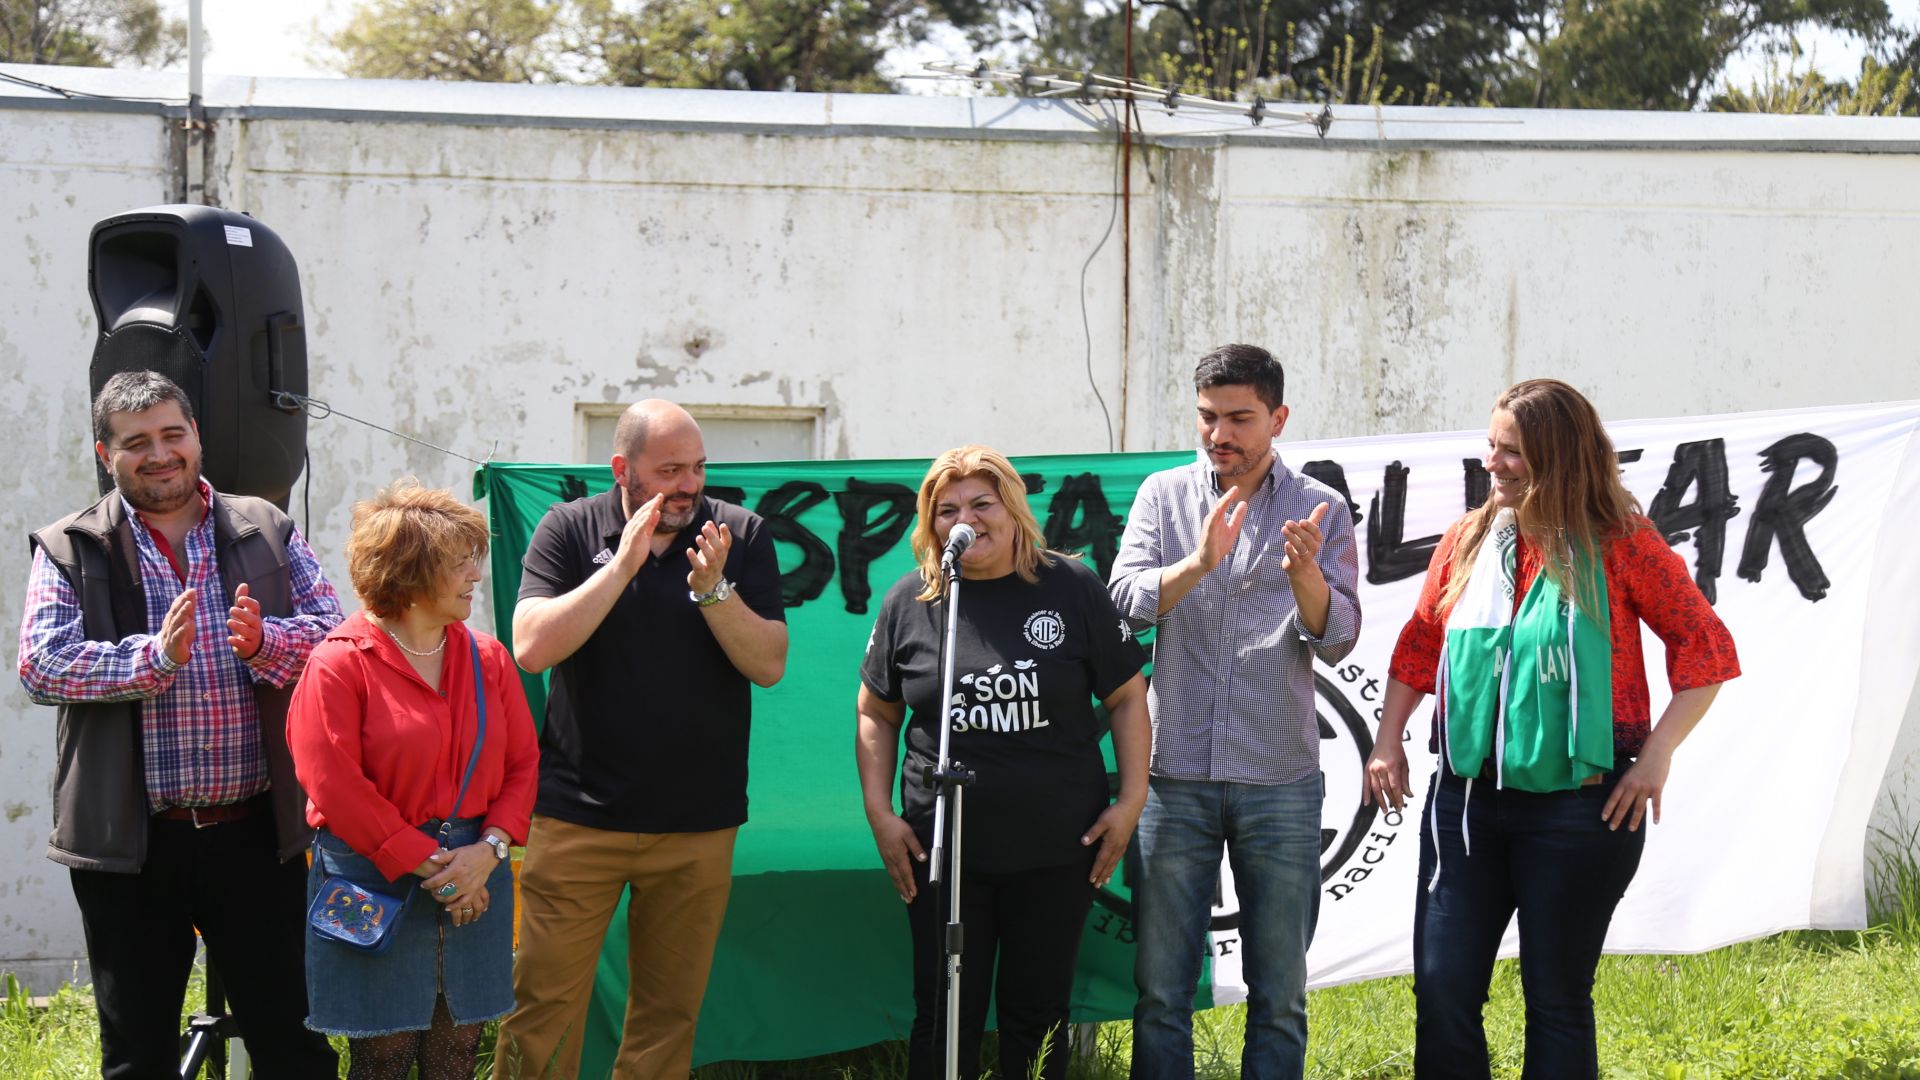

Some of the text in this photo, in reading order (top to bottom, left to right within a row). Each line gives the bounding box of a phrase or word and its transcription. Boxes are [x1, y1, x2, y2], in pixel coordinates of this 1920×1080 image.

[1033, 618, 1058, 642] ATE
[974, 671, 1039, 702] SON
[951, 699, 1050, 733] 30MIL
